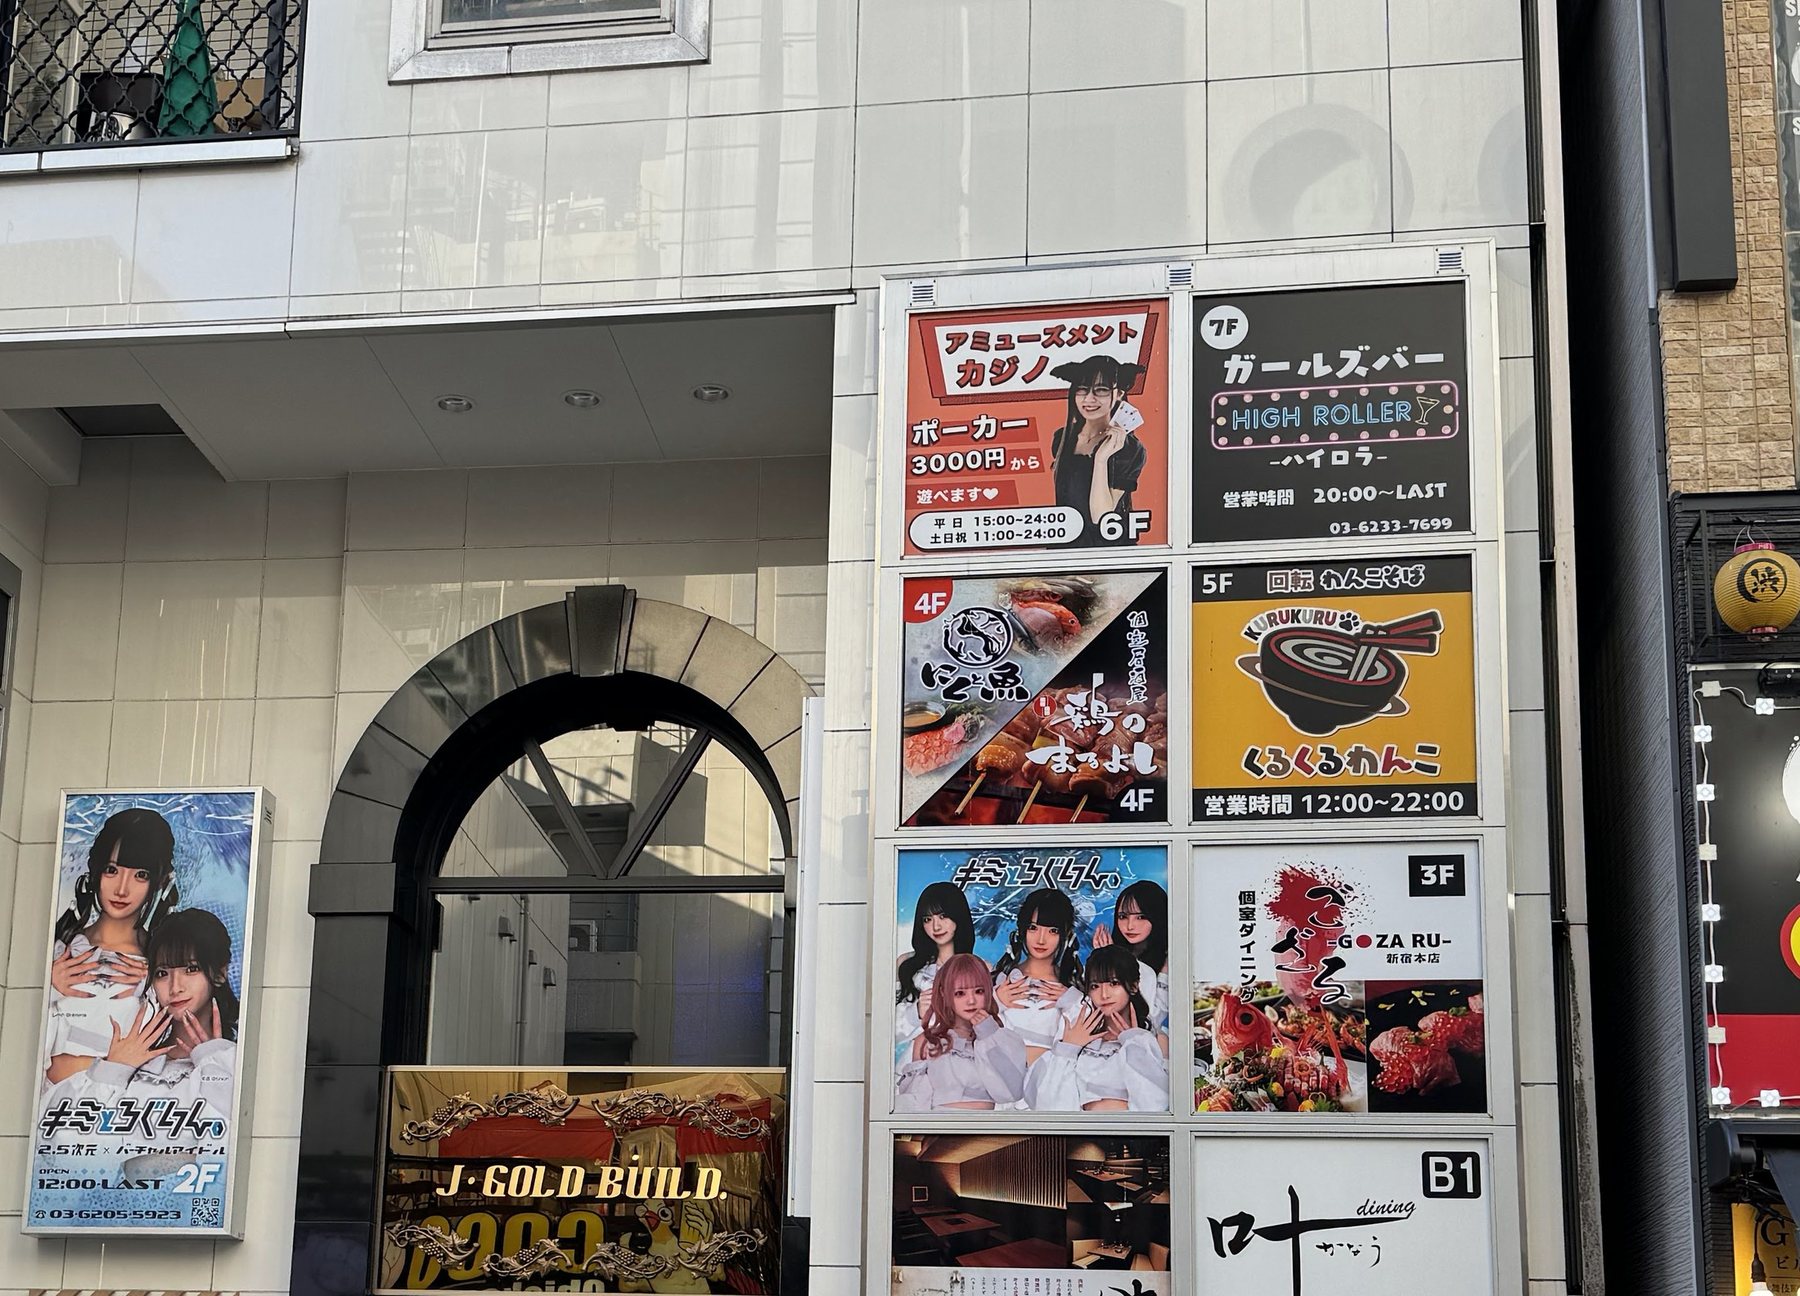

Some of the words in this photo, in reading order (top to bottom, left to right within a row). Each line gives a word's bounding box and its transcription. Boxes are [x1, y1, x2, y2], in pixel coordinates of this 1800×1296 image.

[945, 321, 1138, 355] アミューズメント
[1208, 318, 1239, 337] 7F
[956, 355, 1050, 388] カジノ
[1223, 345, 1444, 385] ガールズバー
[912, 413, 1029, 446] ポーカー
[1232, 406, 1301, 431] HIGH
[1313, 400, 1412, 426] ROLLER
[1222, 488, 1295, 509] 営業時間
[973, 512, 1067, 527] 15:00~24:00
[1099, 510, 1151, 542] 6F
[1329, 517, 1453, 535] 03-6233-7699
[930, 531, 968, 545] 土日祝
[973, 527, 1067, 542] 11:00~24:00
[1201, 572, 1233, 594] 5F
[1266, 569, 1314, 594] 回転
[1320, 563, 1426, 592] わんこそば
[914, 592, 947, 615] 4F
[1242, 608, 1338, 642] KURUKURU
[1126, 609, 1150, 706] 個室居酒屋
[1050, 672, 1147, 737] 鶏の
[1024, 734, 1158, 775] まるよし
[1241, 743, 1441, 780] くるくるわんこ
[1120, 788, 1155, 812] 4F
[1203, 793, 1293, 818] 営業時間
[1301, 790, 1465, 815] 12:00~22:00
[1420, 863, 1455, 886] 3F
[1237, 889, 1258, 1005] 個室ダイニング
[1385, 952, 1441, 965] 新宿本店
[37, 1143, 98, 1157] 2.5次元
[115, 1143, 226, 1156] バーチャルアイドル
[173, 1163, 221, 1195] 2F
[1428, 1155, 1475, 1195] B1
[50, 1209, 182, 1220] 03-6205-5923
[1356, 1198, 1416, 1219] dining
[1315, 1235, 1382, 1269] かなう
